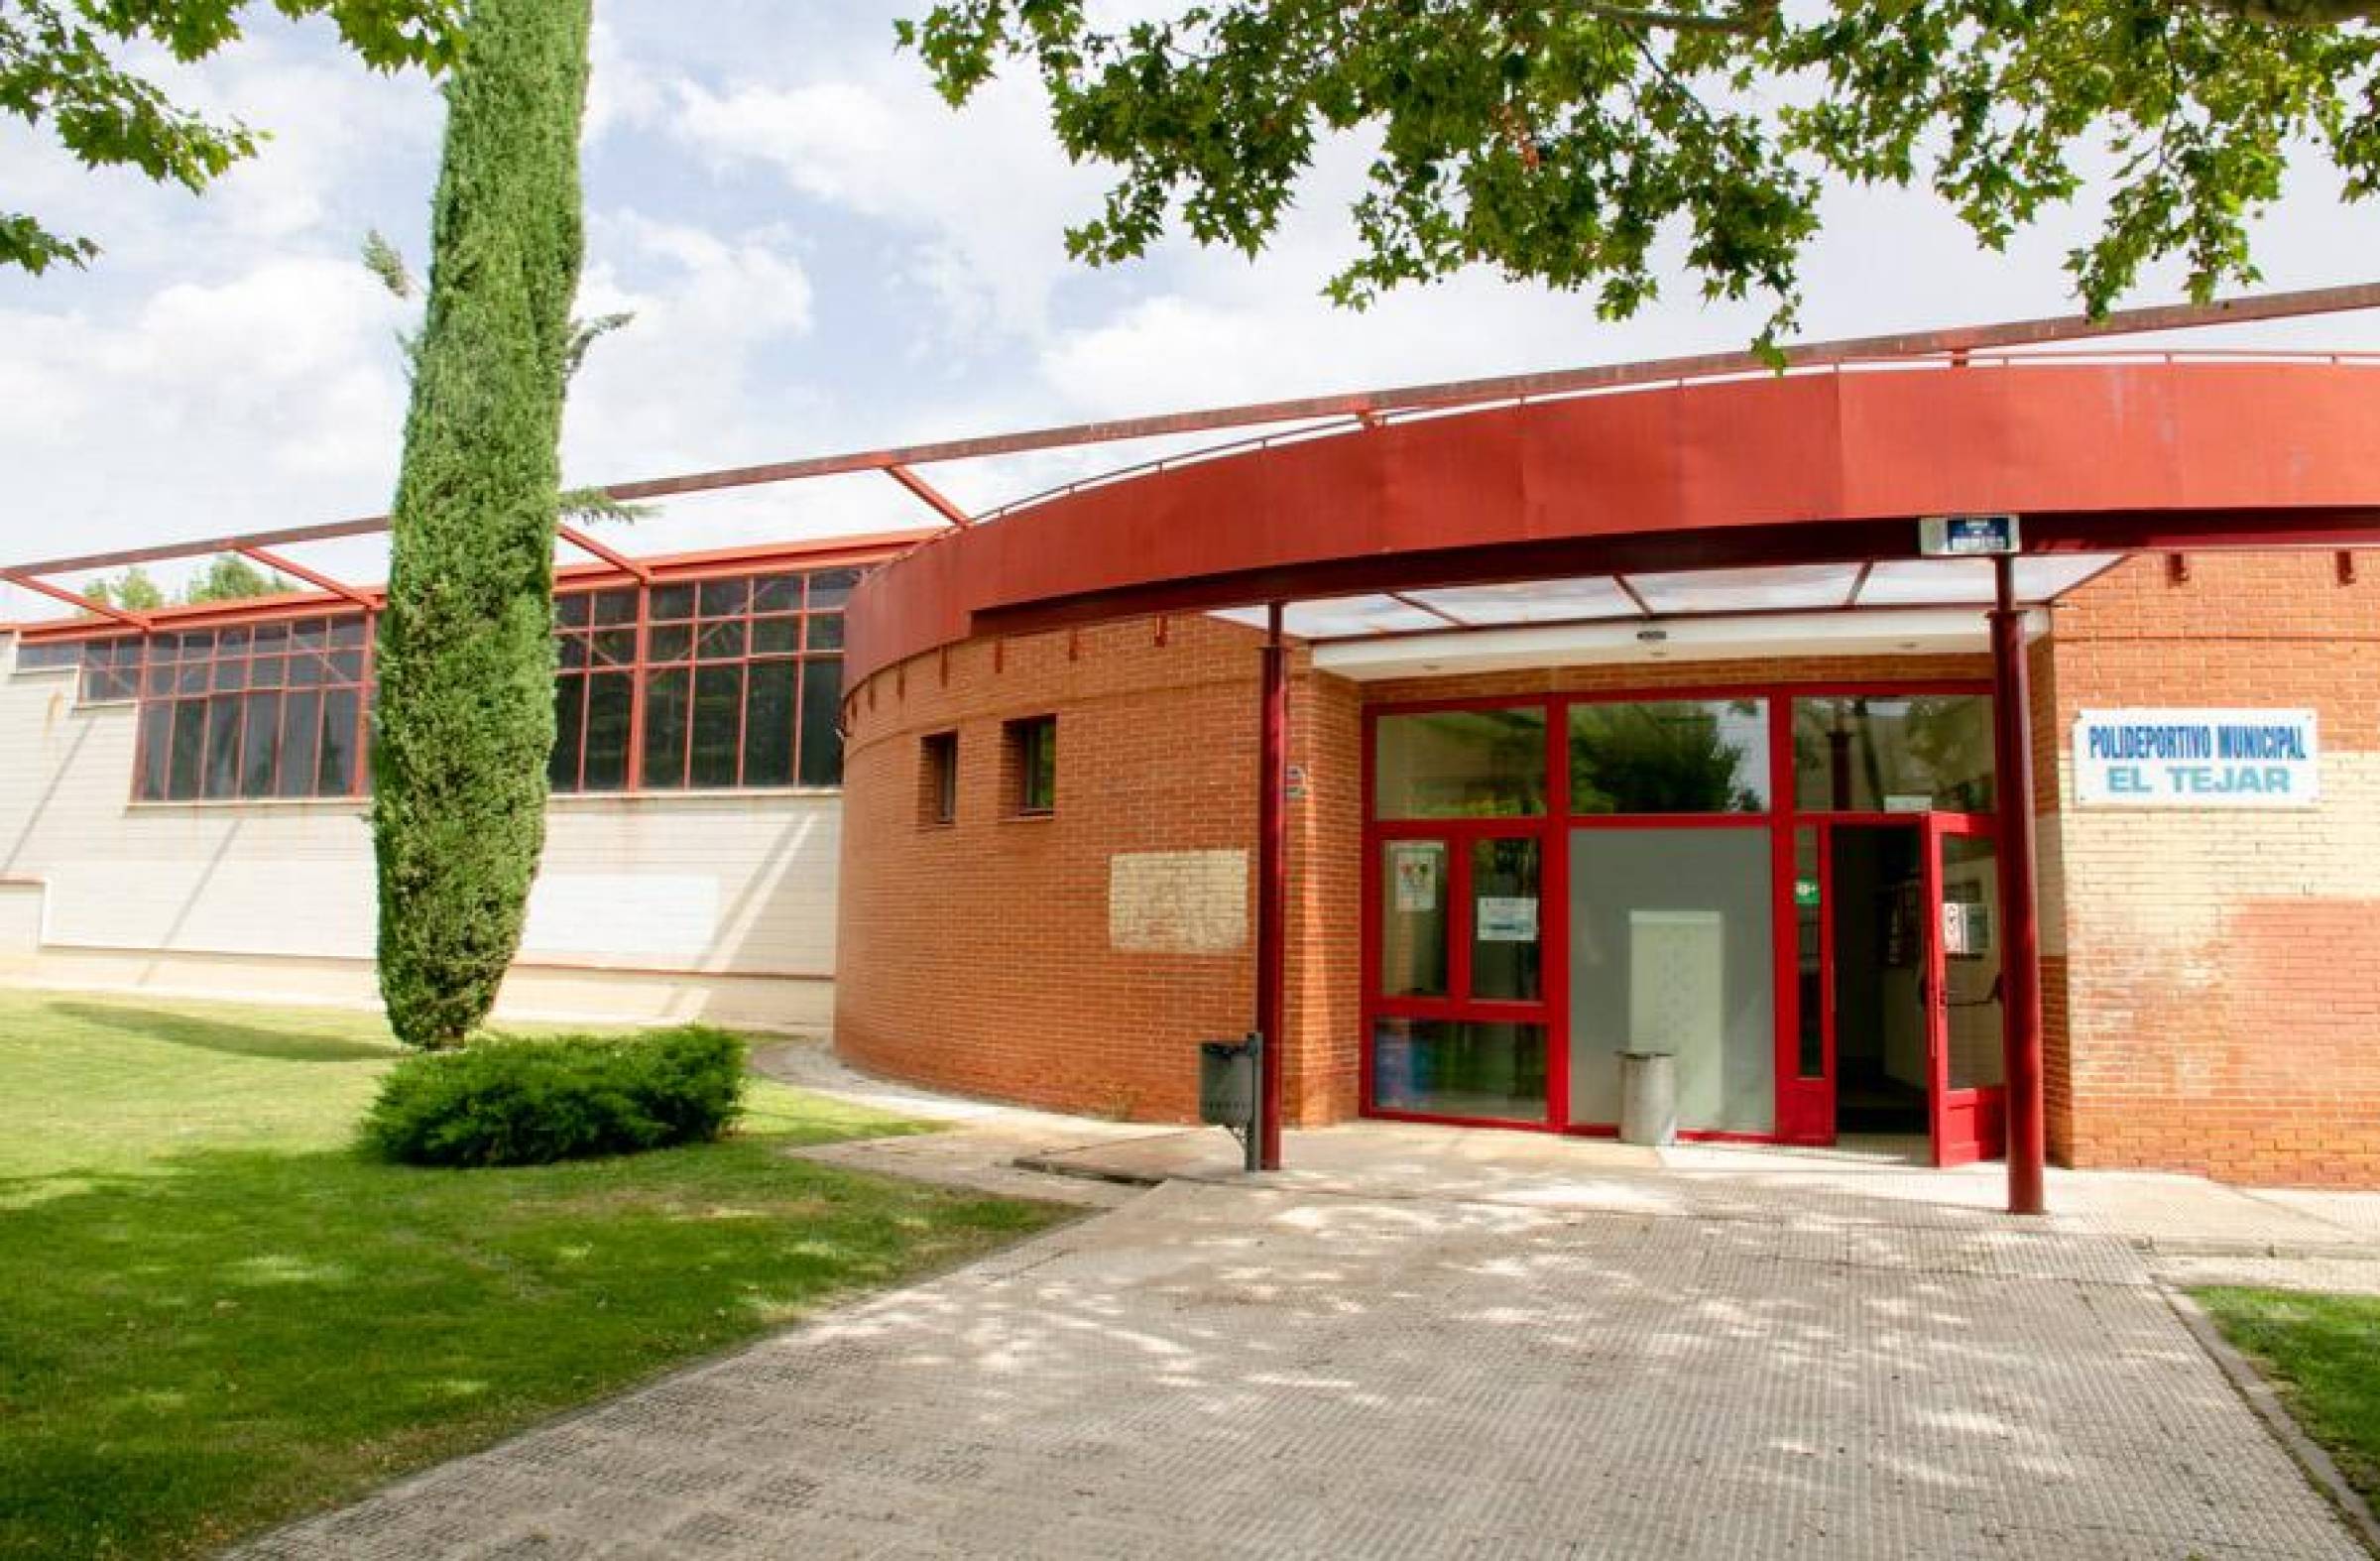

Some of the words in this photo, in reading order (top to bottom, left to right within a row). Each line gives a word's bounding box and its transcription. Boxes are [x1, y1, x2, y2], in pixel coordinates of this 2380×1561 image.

[2088, 725, 2211, 759] POLIDEPORTIVO
[2217, 725, 2307, 759] MUNICIPAL
[2106, 766, 2153, 793] EL
[2165, 766, 2291, 793] TEJAR
